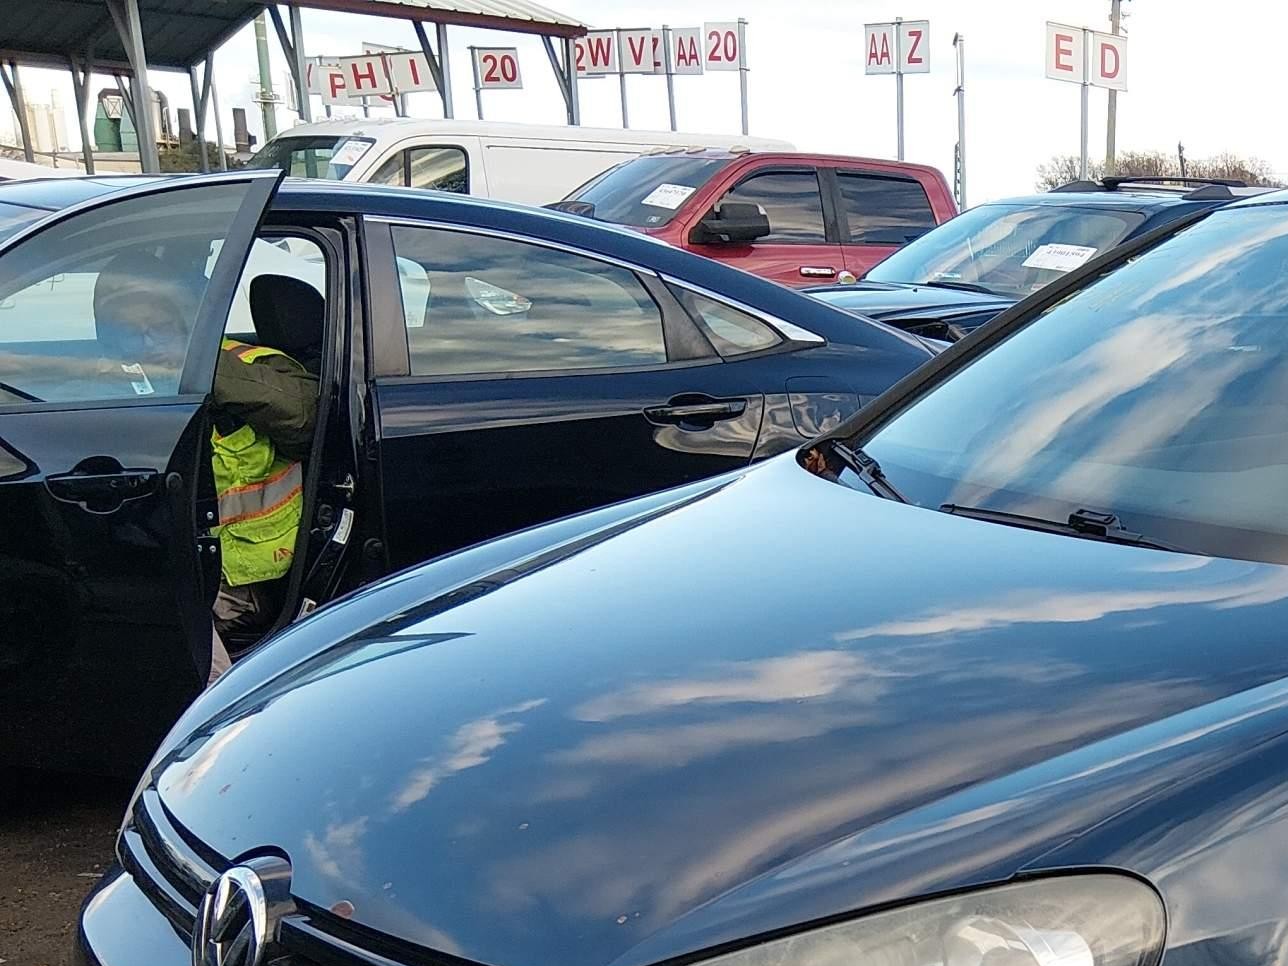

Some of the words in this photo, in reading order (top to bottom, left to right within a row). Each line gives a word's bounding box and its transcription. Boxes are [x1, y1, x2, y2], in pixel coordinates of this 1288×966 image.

[587, 37, 612, 67] W
[627, 36, 646, 66] V
[676, 36, 700, 67] AA
[707, 30, 738, 62] 20
[867, 32, 891, 66] AA
[907, 30, 923, 64] Z
[1054, 33, 1074, 72] E
[1100, 43, 1120, 79] D
[351, 62, 377, 89] H
[409, 58, 420, 85] I
[482, 54, 518, 82] 20
[329, 73, 346, 98] P
